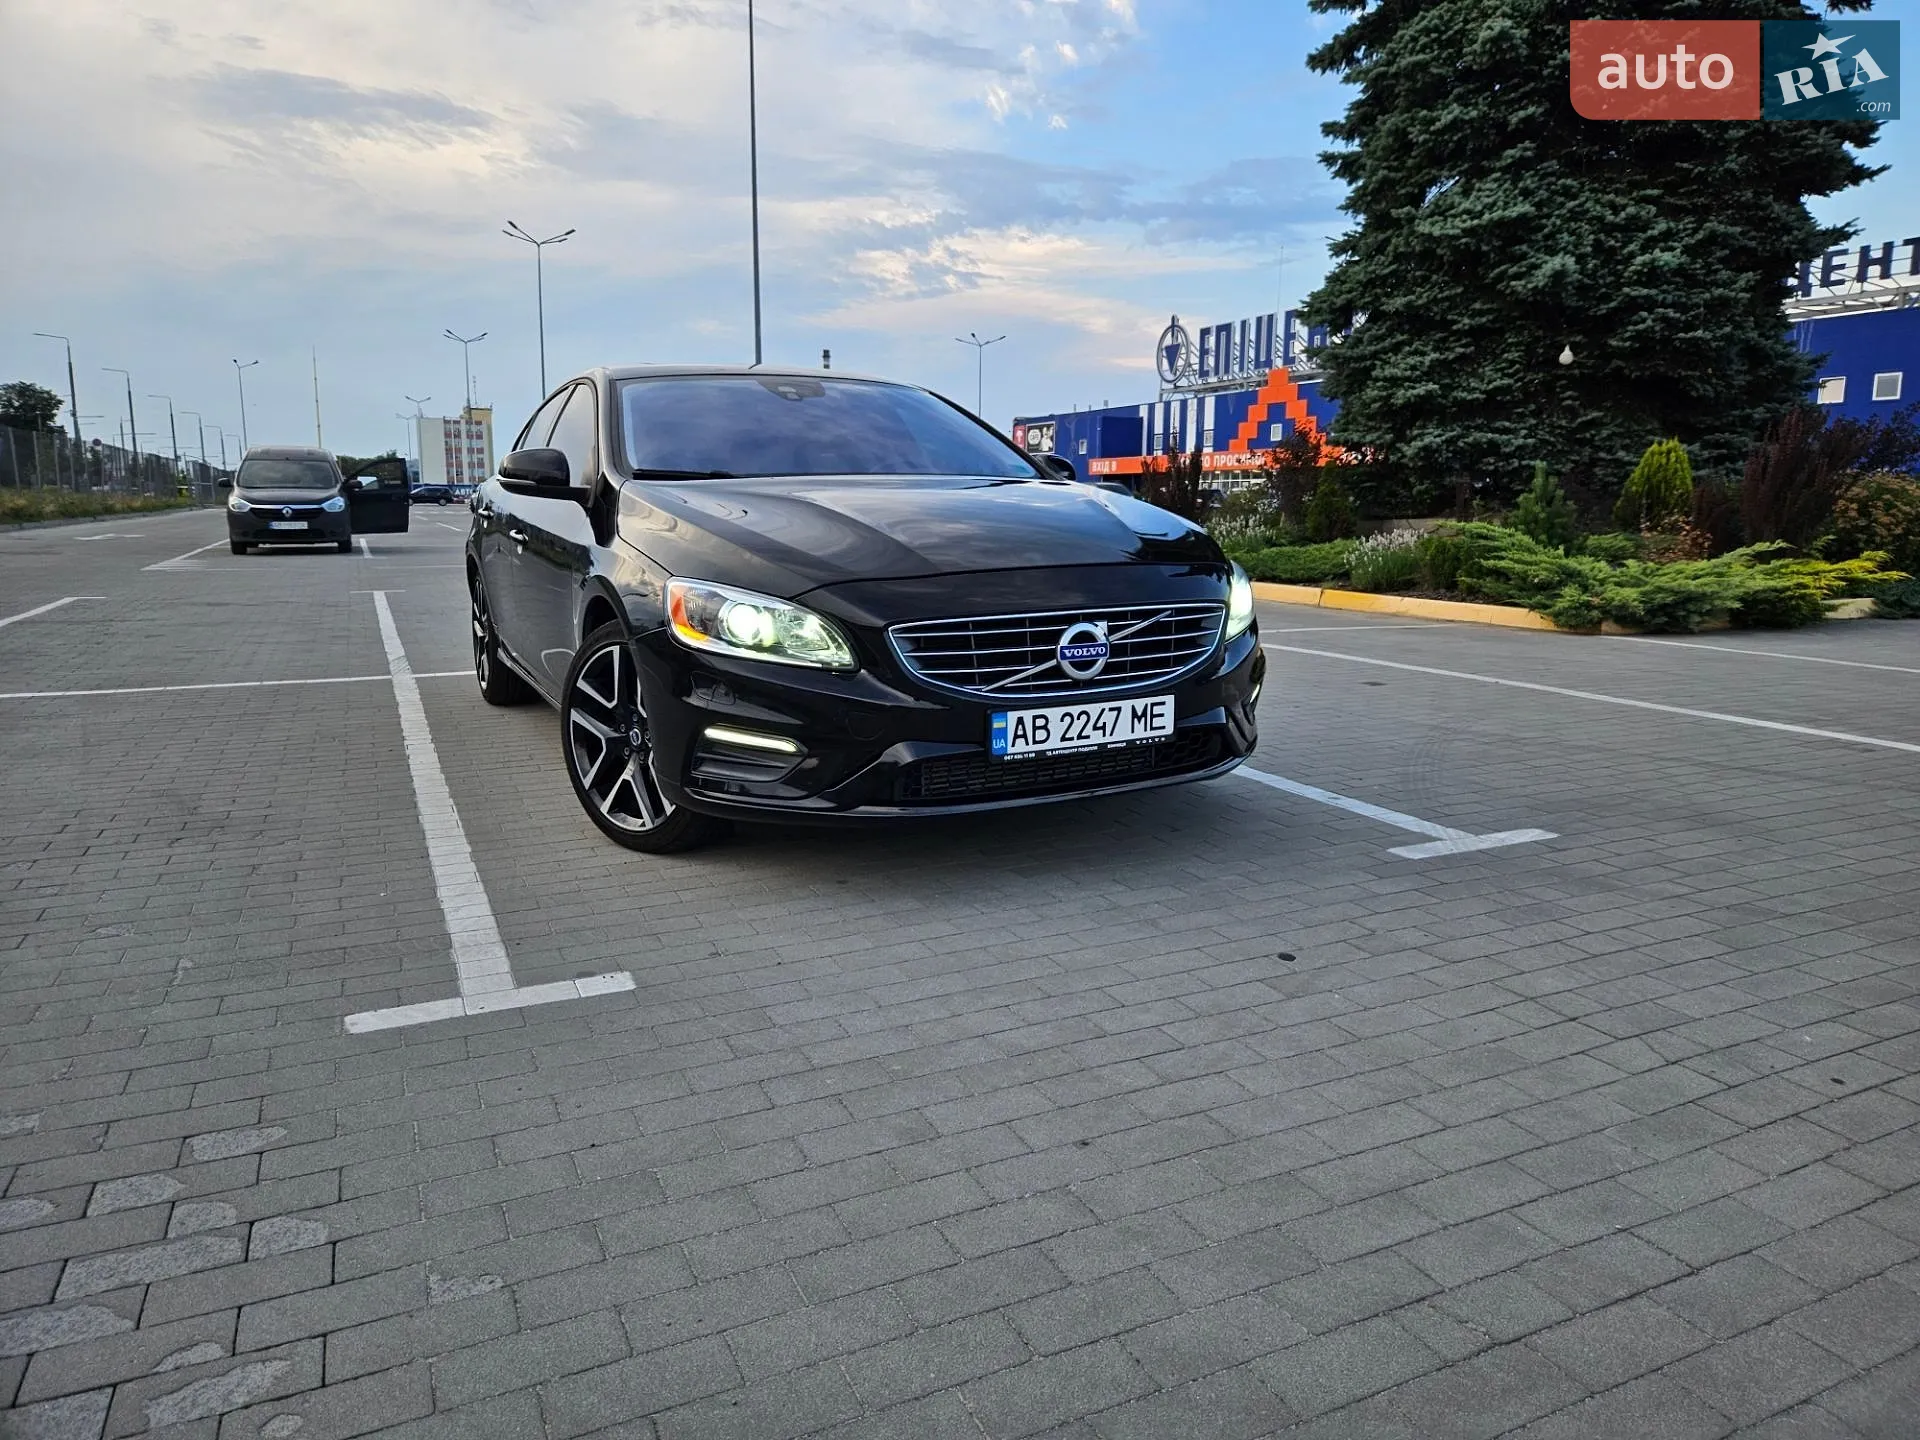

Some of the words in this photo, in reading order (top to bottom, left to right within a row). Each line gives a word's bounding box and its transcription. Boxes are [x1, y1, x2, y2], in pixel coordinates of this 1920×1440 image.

[1061, 646, 1106, 657] VOLVO
[1011, 714, 1050, 748] AB
[1060, 706, 1122, 743] 2247
[1131, 701, 1166, 734] ME
[992, 738, 1006, 749] UA
